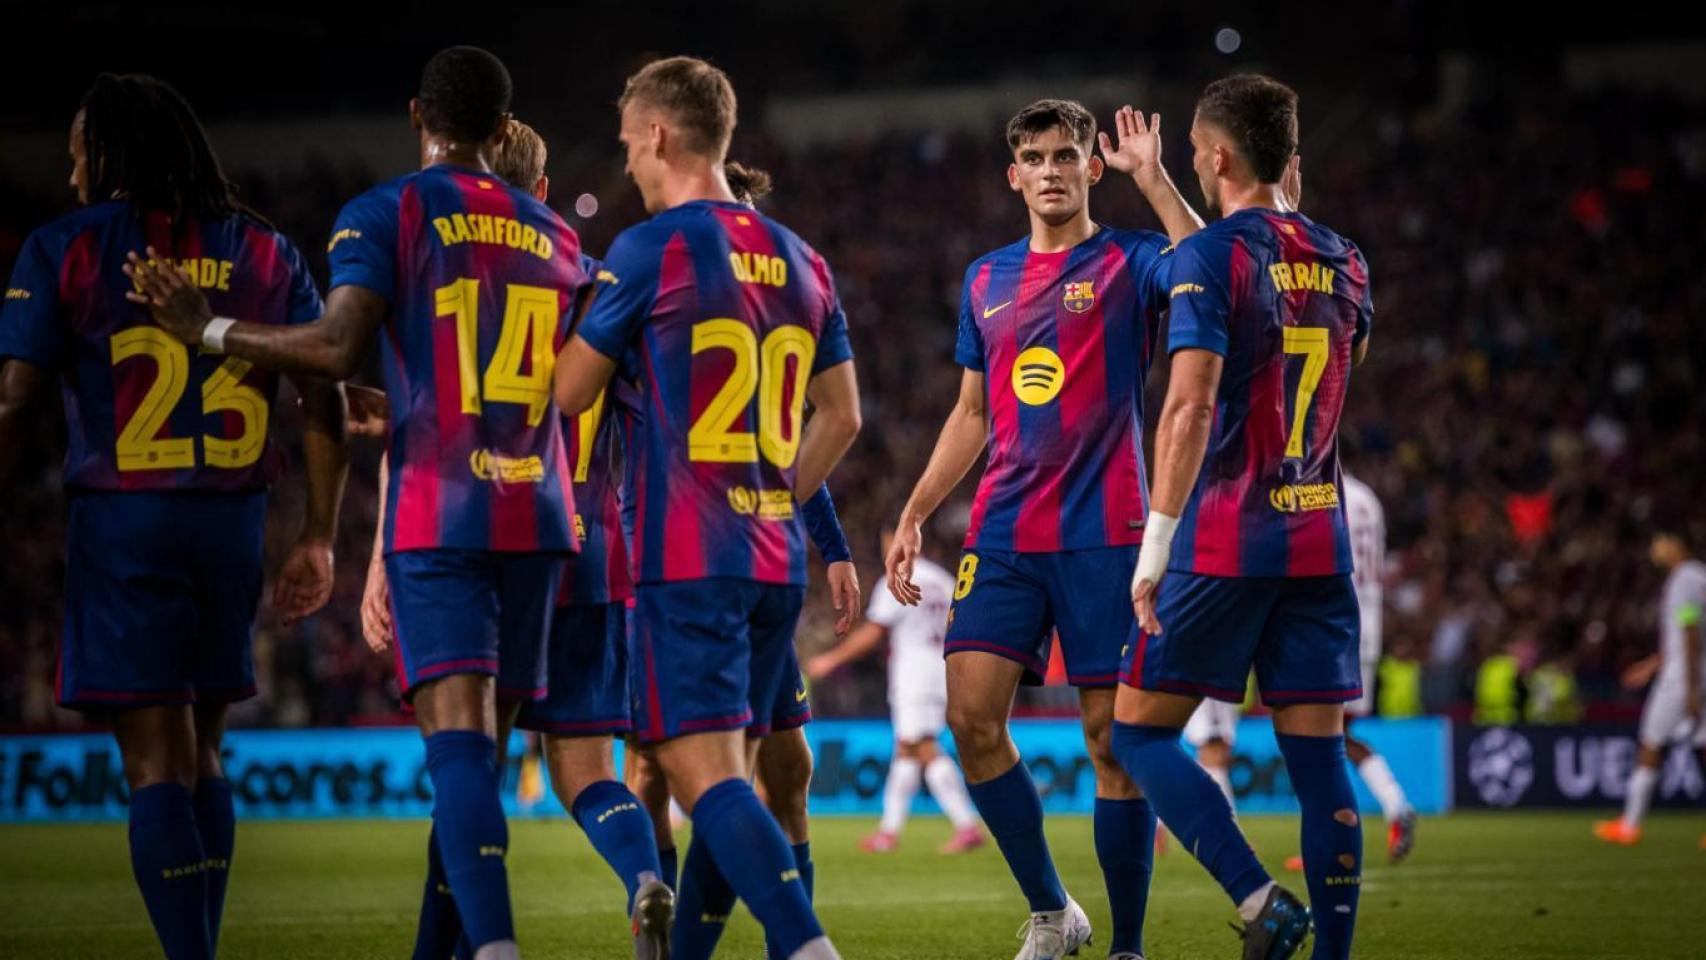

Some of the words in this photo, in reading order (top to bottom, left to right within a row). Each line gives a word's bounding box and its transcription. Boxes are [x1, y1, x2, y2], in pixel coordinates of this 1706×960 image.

[432, 213, 553, 261] RASHFORD
[729, 252, 787, 288] OLMO
[110, 325, 270, 472] 23
[433, 277, 560, 428] 14
[688, 318, 816, 469] 20
[1282, 327, 1329, 459] 7
[953, 553, 979, 600] 8
[1553, 736, 1704, 800] UEA
